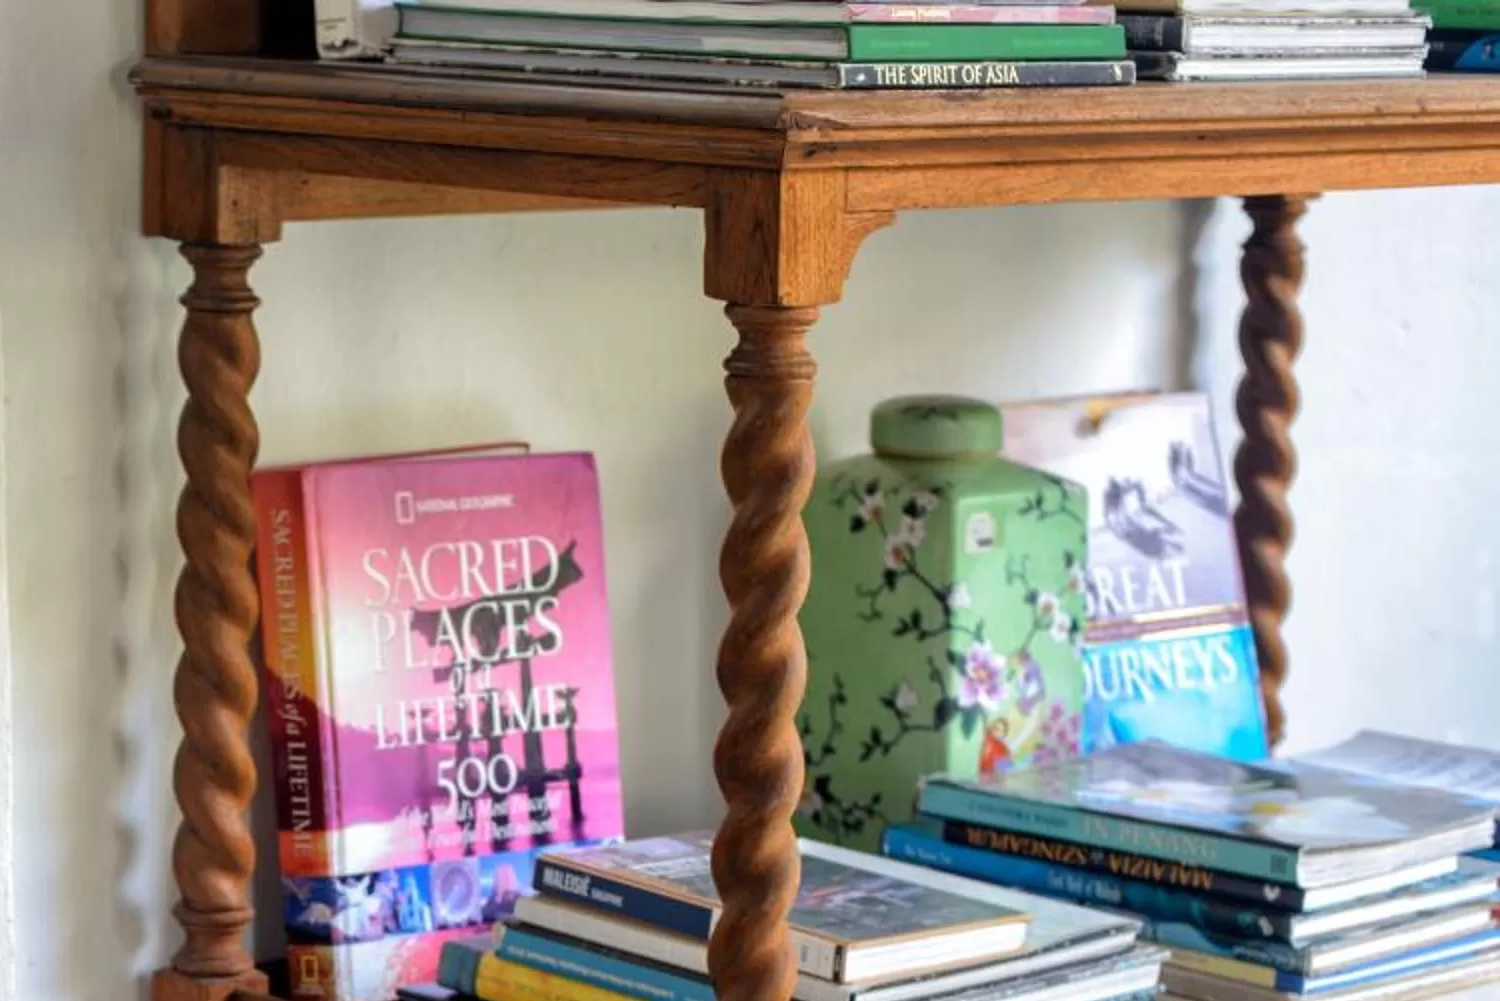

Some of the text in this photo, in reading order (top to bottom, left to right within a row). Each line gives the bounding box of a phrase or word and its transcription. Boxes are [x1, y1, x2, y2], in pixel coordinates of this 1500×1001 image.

[874, 64, 1020, 85] THE SPIRIT OF ASIA
[361, 535, 561, 607] SACRED
[372, 596, 564, 673] PLACES
[374, 682, 572, 751] LIFETIME
[436, 753, 519, 814] 500
